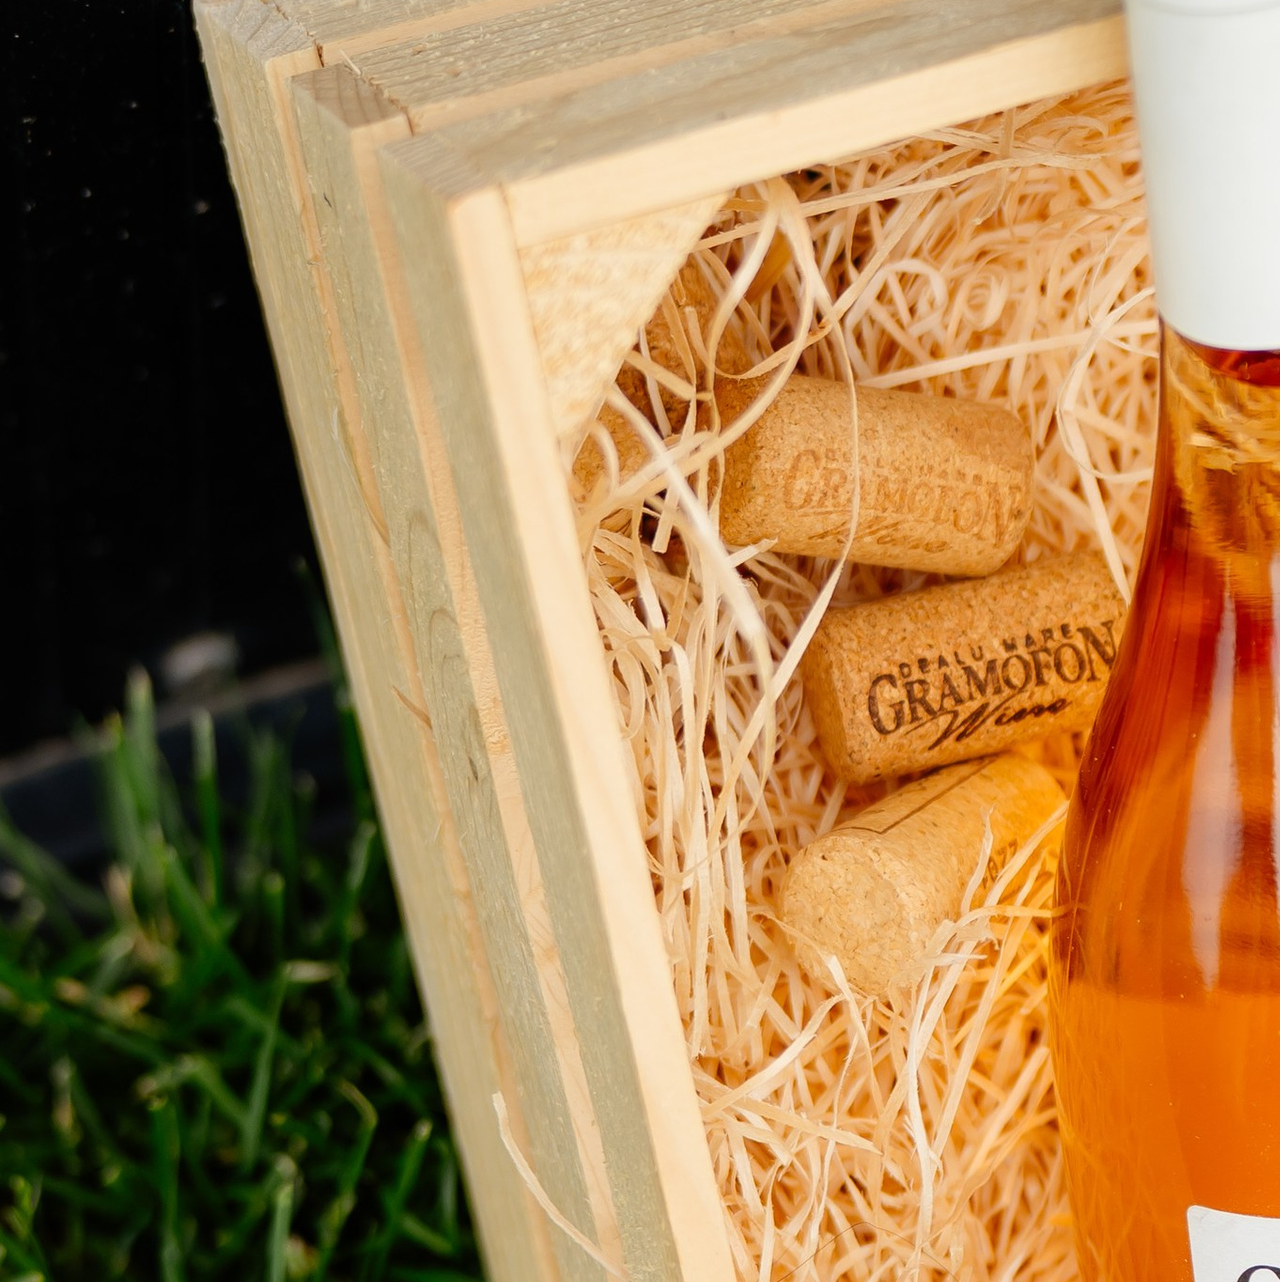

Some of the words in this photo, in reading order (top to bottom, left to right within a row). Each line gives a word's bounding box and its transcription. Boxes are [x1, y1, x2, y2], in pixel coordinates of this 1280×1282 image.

[867, 620, 1116, 735] GRAMOFON
[898, 645, 984, 679] DEALU
[1002, 623, 1073, 653] MARE
